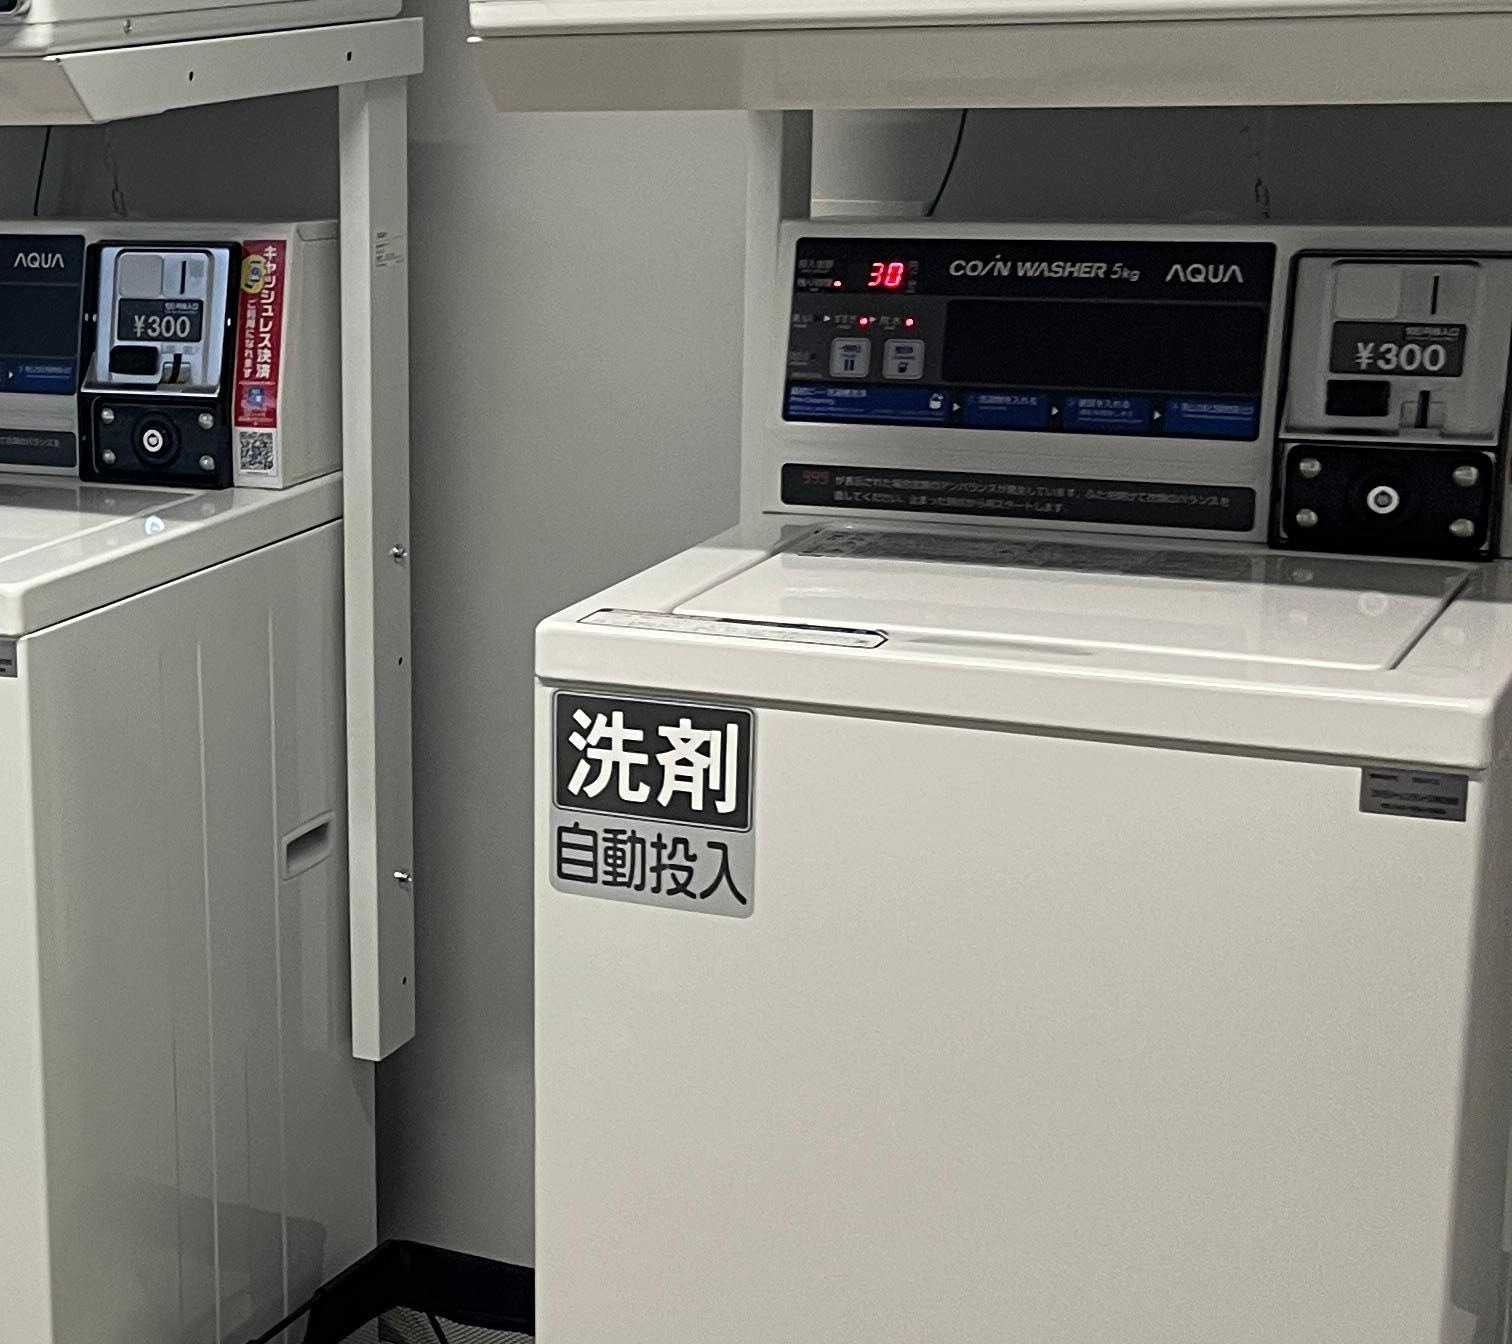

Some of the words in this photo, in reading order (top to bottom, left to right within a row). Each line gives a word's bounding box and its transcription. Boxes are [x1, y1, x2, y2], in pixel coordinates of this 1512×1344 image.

[13, 252, 64, 268] AQUA
[1016, 261, 1108, 279] WASHER
[1165, 263, 1244, 284] AQUA
[867, 261, 905, 288] 30
[133, 315, 191, 338] ¥300
[255, 245, 278, 380] キャッシュレス決済
[1355, 341, 1447, 371] ¥300
[567, 707, 739, 814] 洗剤
[556, 821, 748, 906] 自動投入
